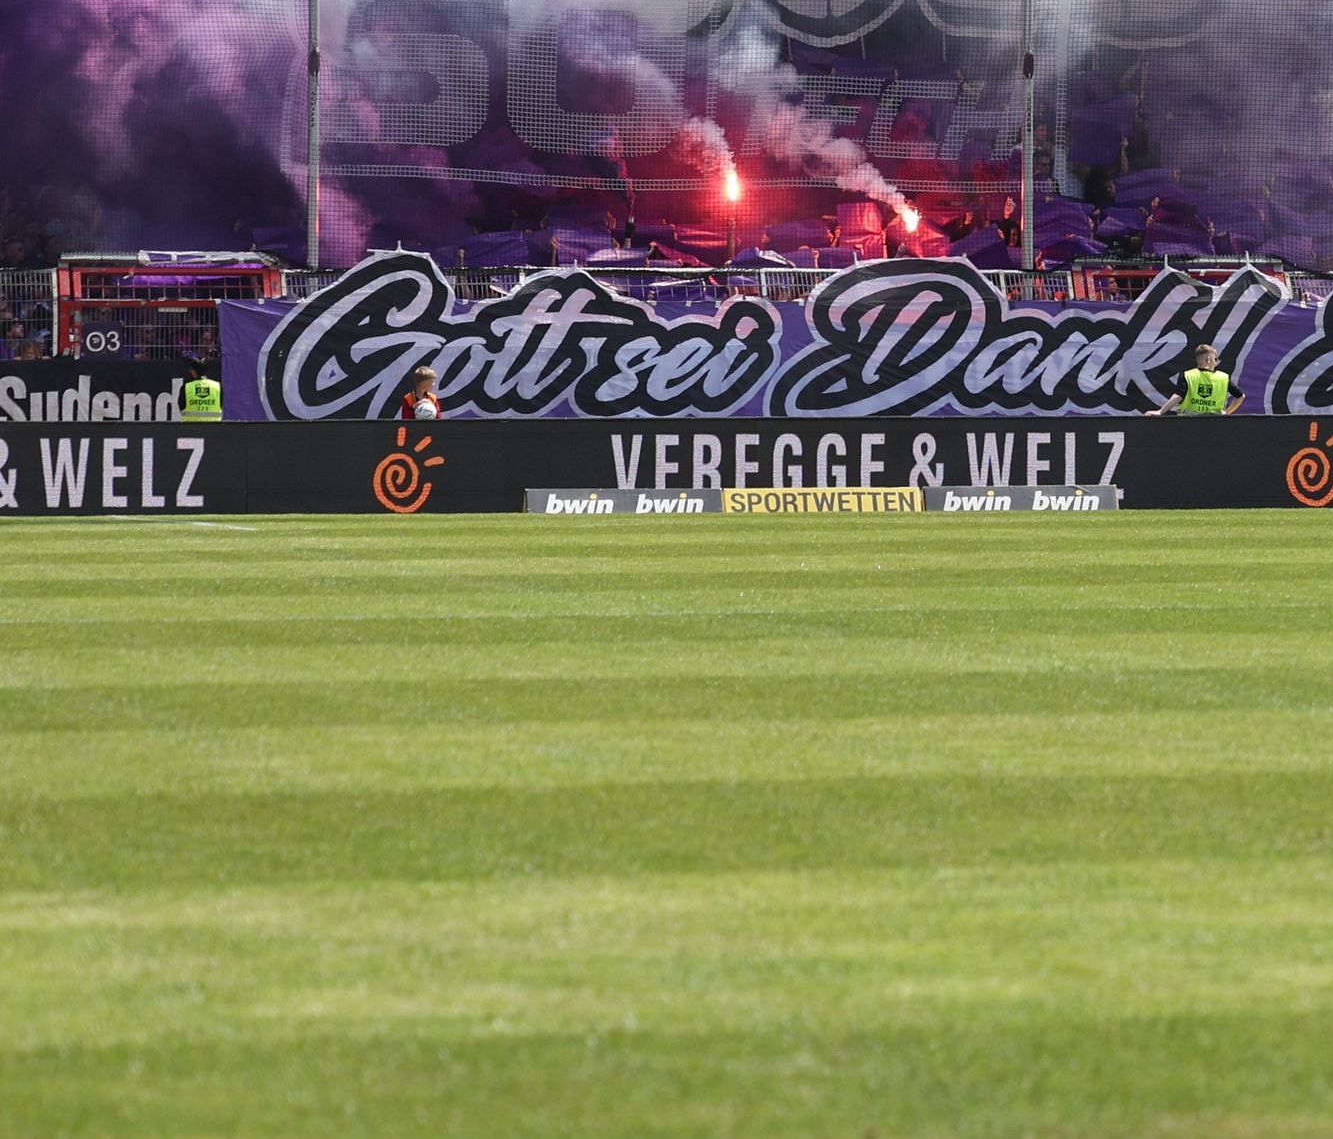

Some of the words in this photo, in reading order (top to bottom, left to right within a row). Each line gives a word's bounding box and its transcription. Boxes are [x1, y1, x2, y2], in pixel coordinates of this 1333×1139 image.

[282, 269, 632, 420] Gott
[596, 309, 765, 408] sei
[786, 274, 1274, 414] Dank!
[1191, 397, 1217, 407] ORDNER
[39, 437, 205, 509] WELZ
[908, 432, 945, 489] &
[546, 492, 615, 514] bwin
[635, 492, 704, 514] bwin
[729, 490, 915, 513] SPORTWETTEN
[943, 489, 1011, 512] bwin
[1031, 488, 1100, 511] bwin
